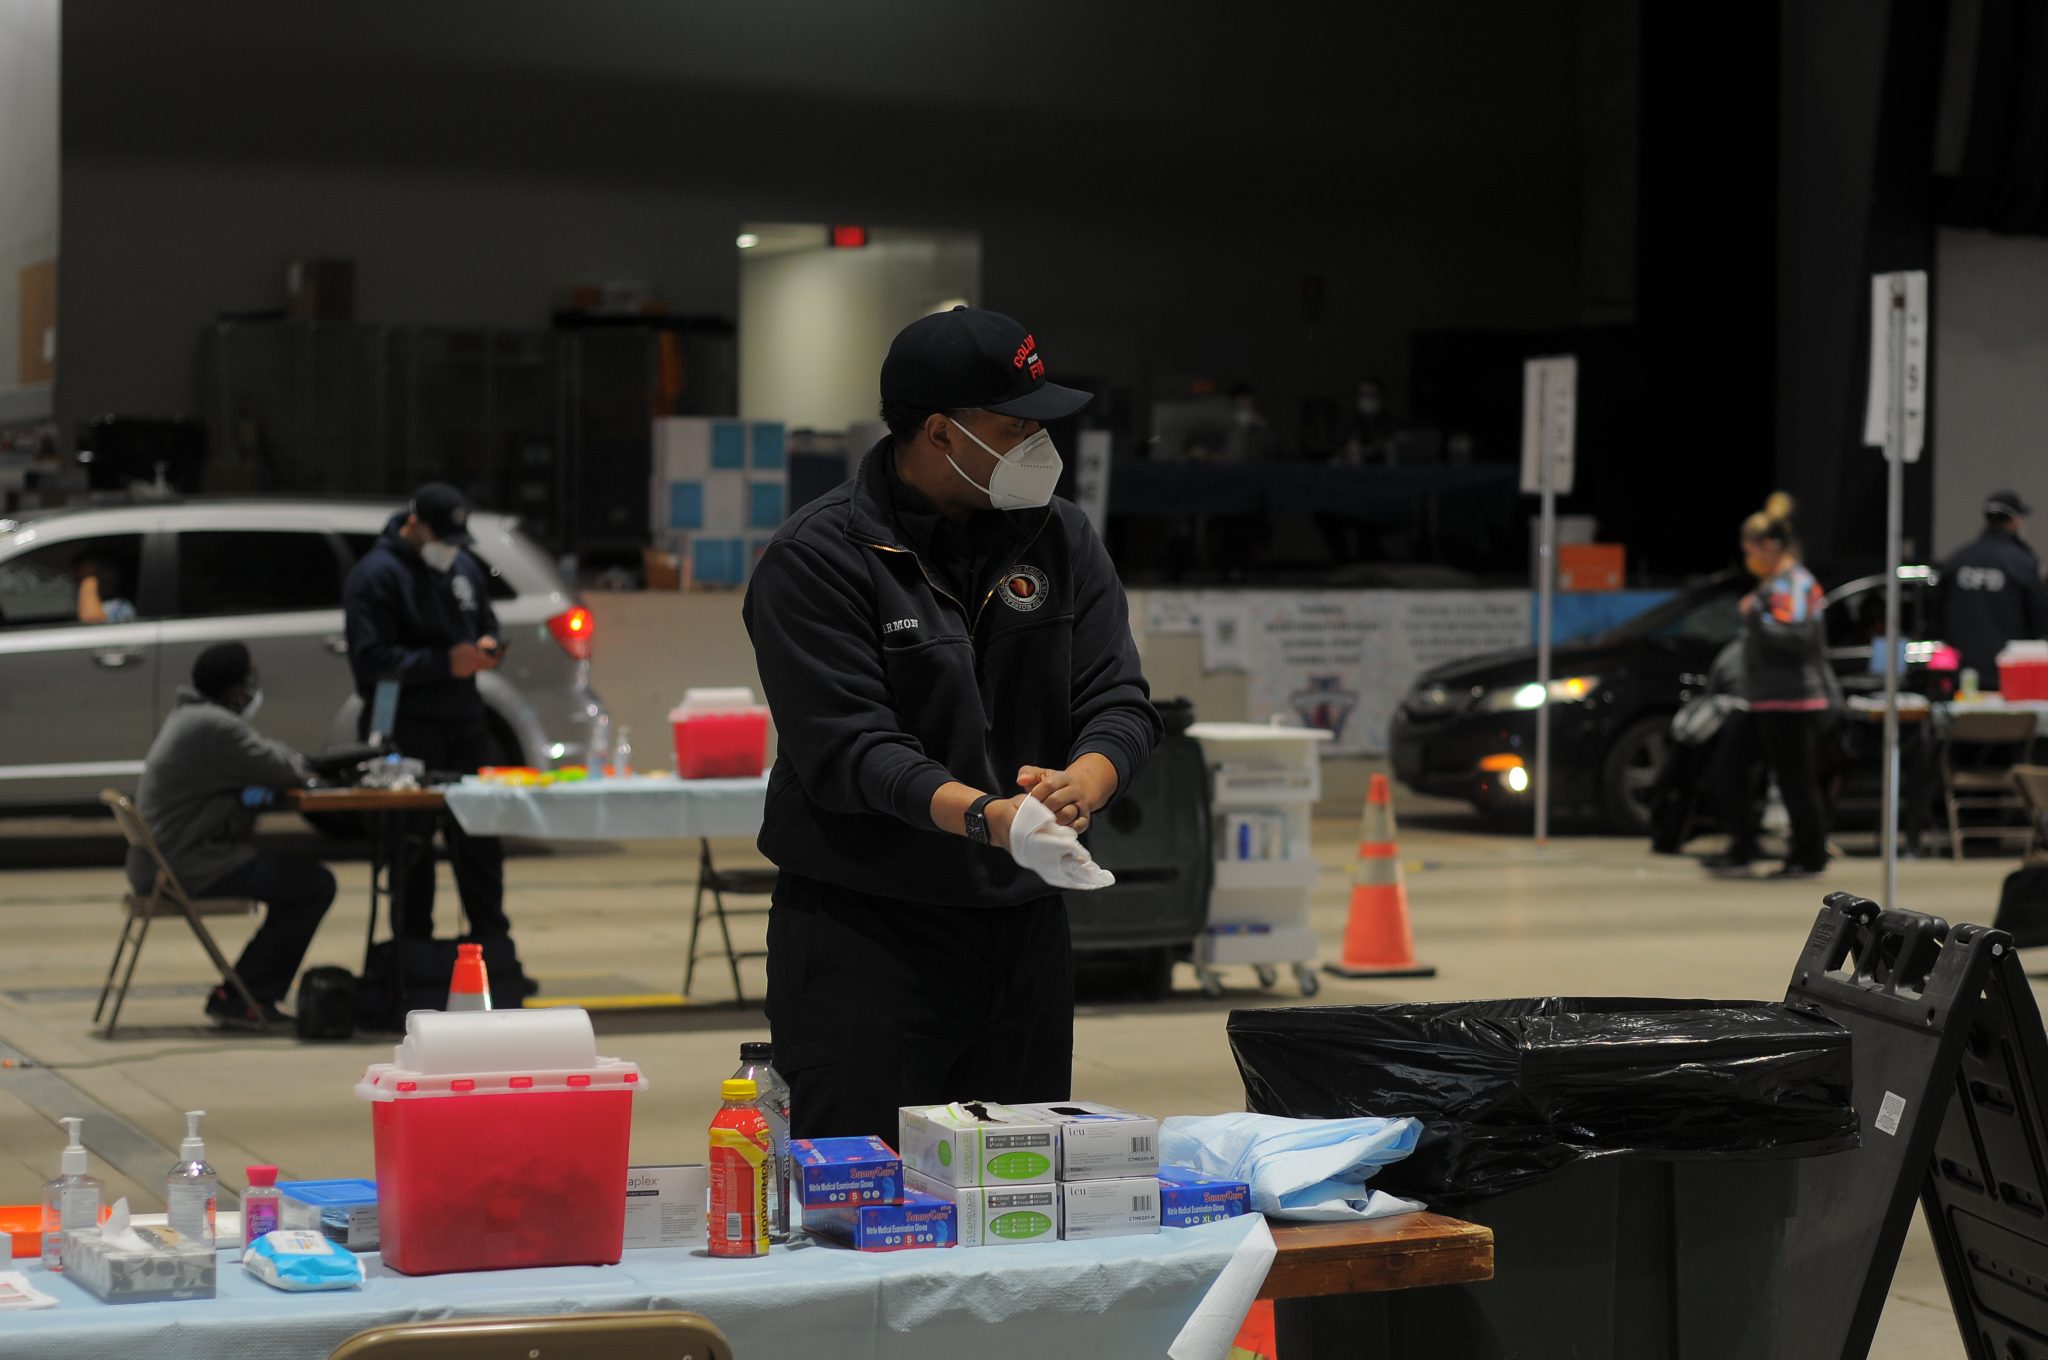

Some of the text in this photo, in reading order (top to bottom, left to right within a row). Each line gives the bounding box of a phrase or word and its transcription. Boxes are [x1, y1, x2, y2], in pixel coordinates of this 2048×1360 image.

[761, 1158, 769, 1236] BODYARMOR
[852, 1192, 857, 1200] S
[907, 1235, 912, 1243] S
